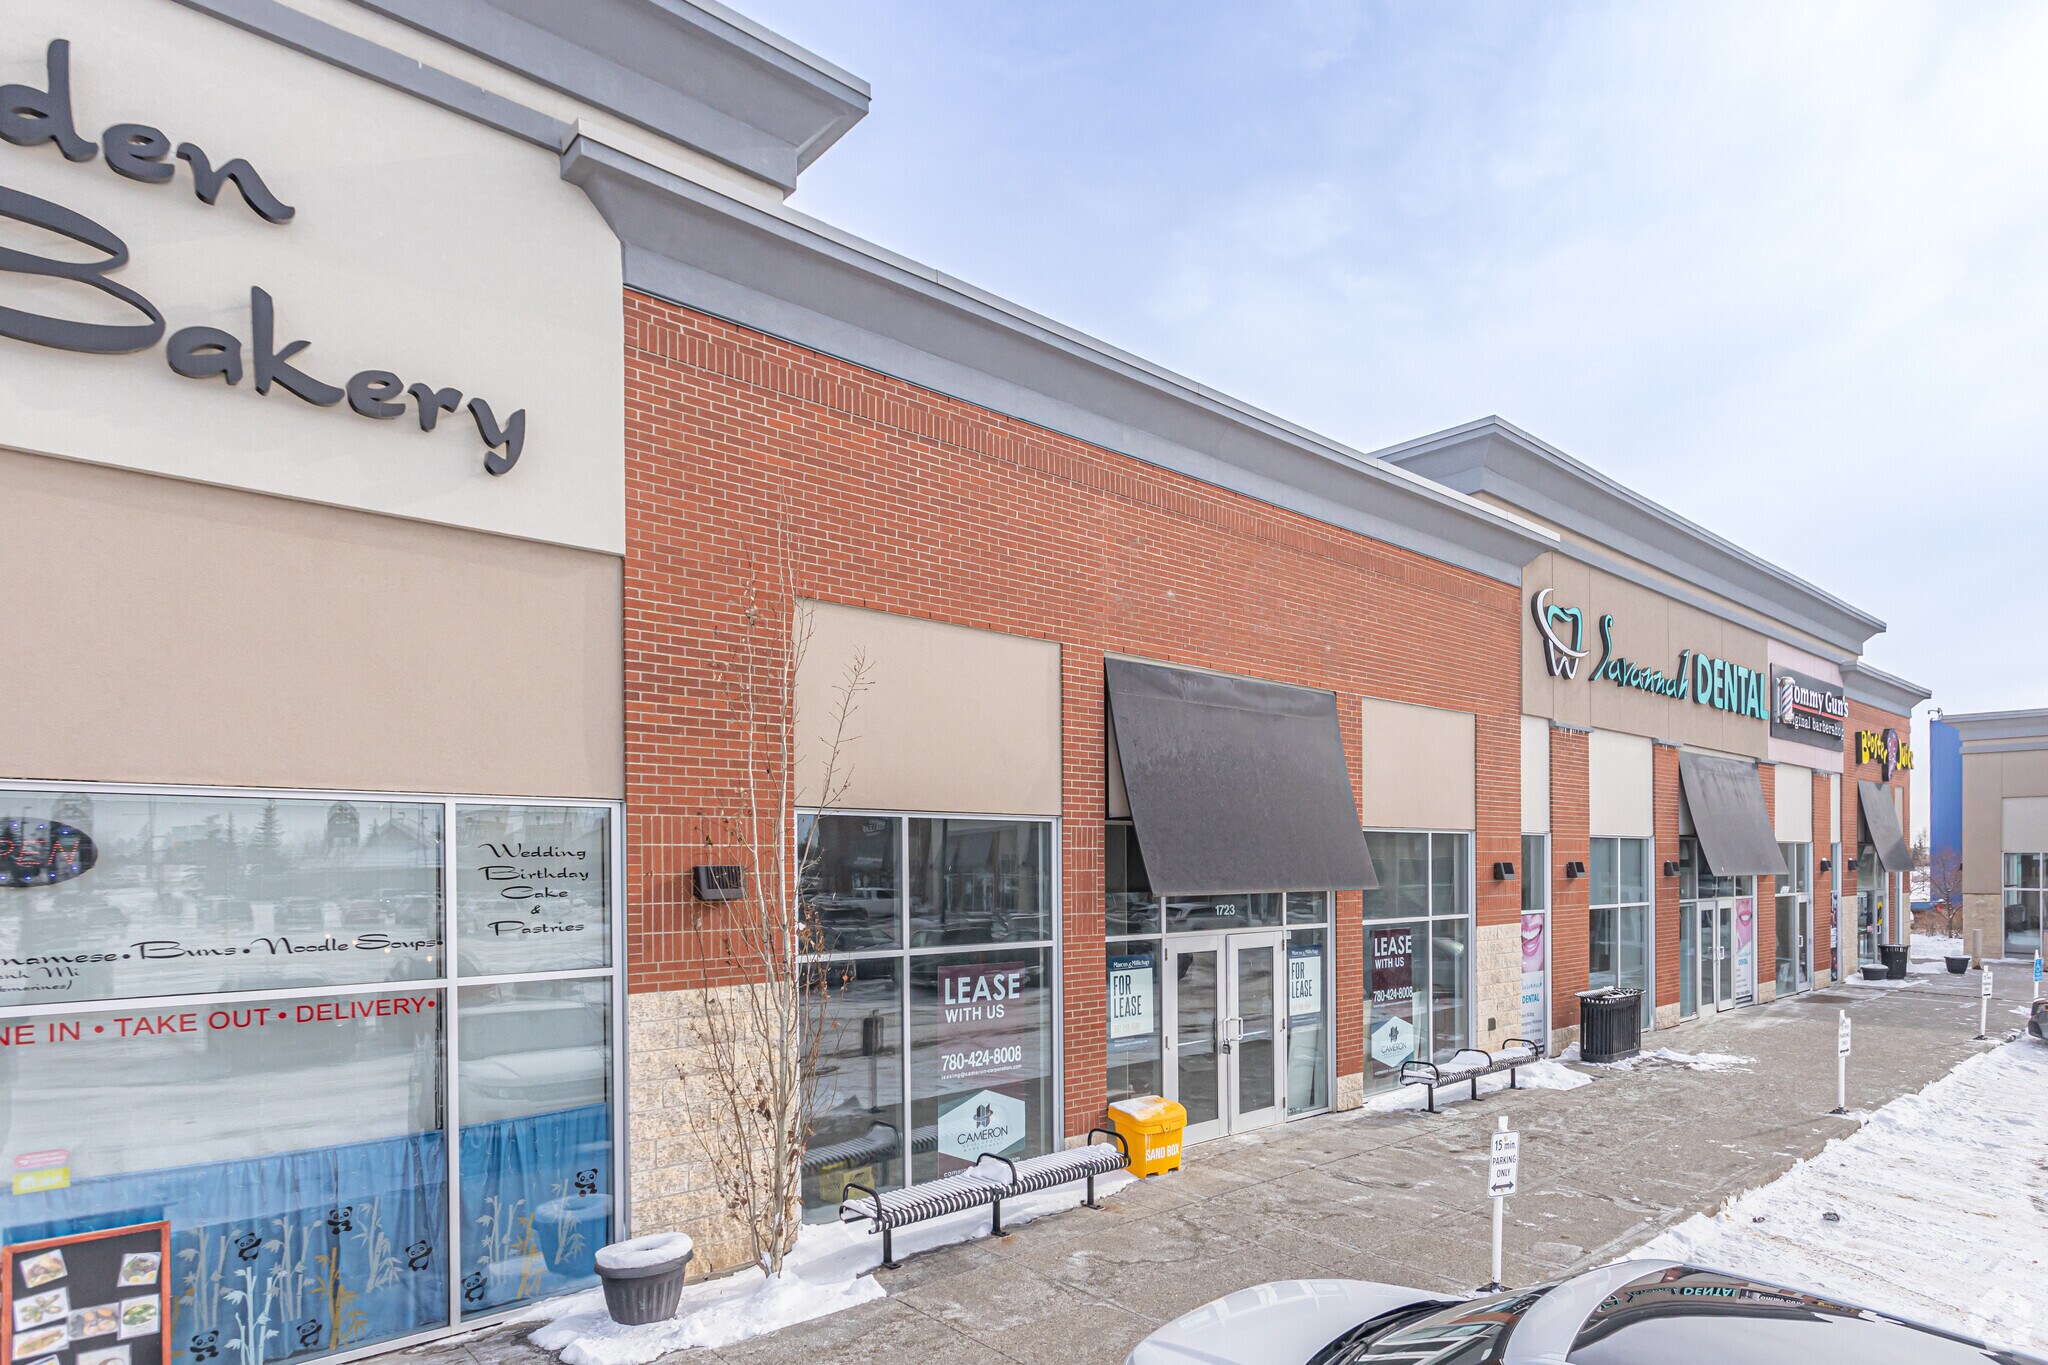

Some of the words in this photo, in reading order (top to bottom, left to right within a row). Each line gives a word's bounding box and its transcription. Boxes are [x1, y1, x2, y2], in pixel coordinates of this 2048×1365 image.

[0, 38, 296, 225] den
[1588, 614, 1690, 699] Savannah
[1692, 652, 1769, 720] DENTAL
[1793, 685, 1824, 715] ommy
[1825, 691, 1849, 718] Gun's
[1791, 714, 1811, 729] iginal
[1861, 729, 1888, 765] Booster
[478, 843, 586, 860] Wedding
[477, 865, 589, 881] Birthday
[500, 885, 568, 899] Cake
[530, 904, 541, 915] &
[1215, 904, 1235, 916] 1723
[487, 920, 585, 936] Pastries
[130, 940, 237, 960] Buns
[251, 937, 349, 955] Noodle
[355, 933, 436, 952] Soups
[1374, 936, 1412, 957] LEASE
[34, 966, 80, 978] Mi
[1291, 962, 1305, 980] FOR
[1375, 958, 1393, 970] WITH
[1394, 956, 1405, 967] US
[944, 973, 1020, 1005] LEASE
[1113, 974, 1132, 997] FOR
[1291, 980, 1313, 999] LEASE
[1113, 995, 1142, 1018] LEASE
[1522, 993, 1540, 1004] DENTAL
[49, 1021, 80, 1043] IN
[113, 1013, 198, 1037] TAKE
[208, 1008, 271, 1030] OUT
[296, 996, 426, 1023] DELIVERY
[945, 1007, 981, 1023] WITH
[986, 1003, 1005, 1019] US
[942, 1045, 1022, 1072] 780-424-8008
[957, 1125, 1008, 1145] CAMERON
[1146, 1146, 1165, 1162] SAND
[1166, 1143, 1180, 1157] BOX
[1495, 1140, 1503, 1151] 15
[1504, 1140, 1517, 1150] min.
[1492, 1155, 1517, 1166] PARKING
[1496, 1168, 1512, 1178] ONLY
